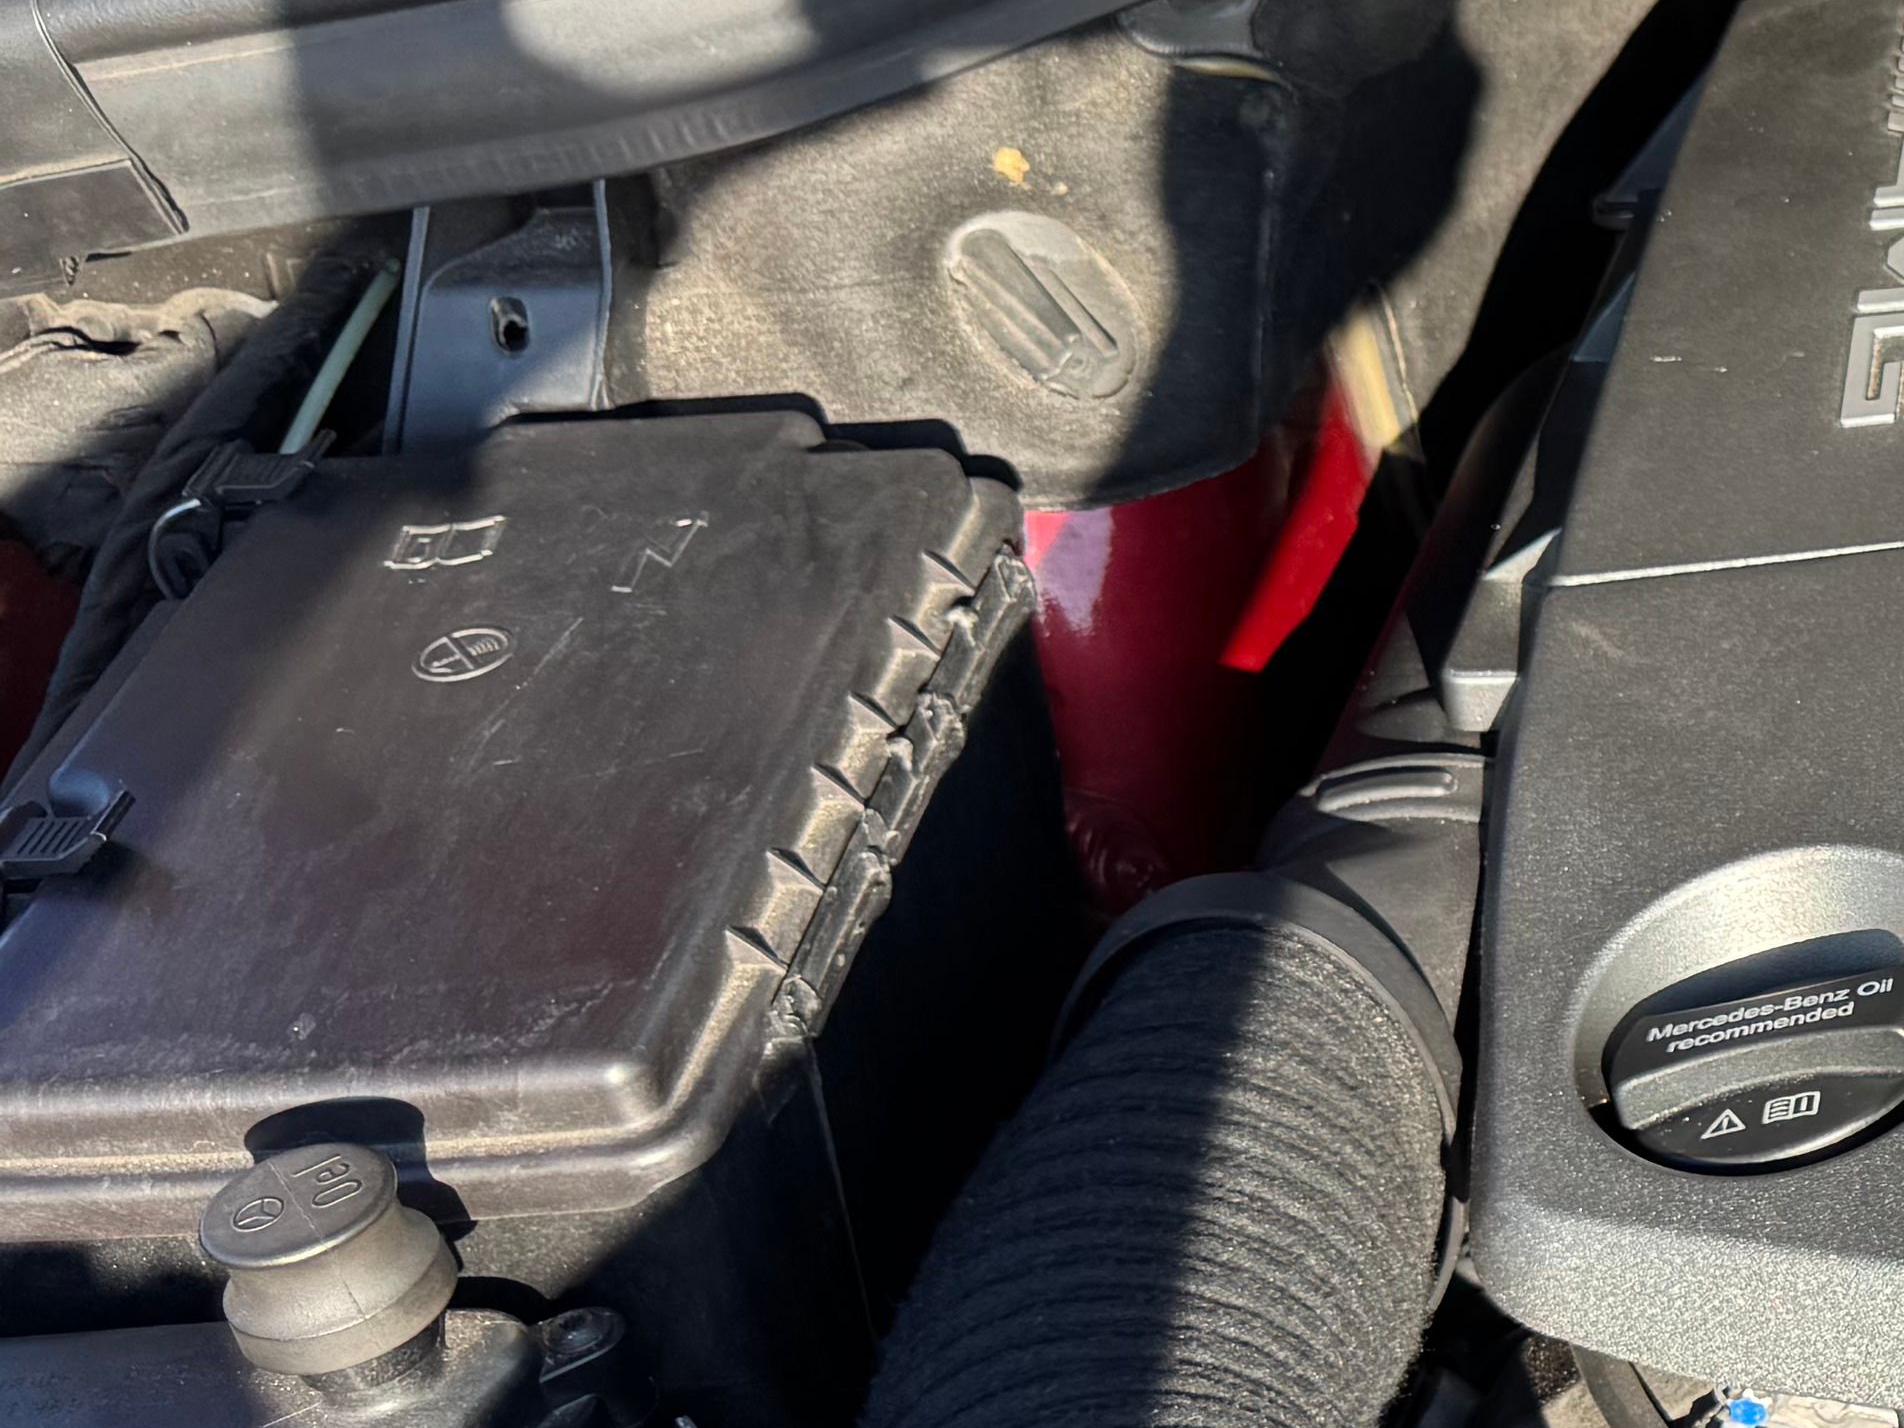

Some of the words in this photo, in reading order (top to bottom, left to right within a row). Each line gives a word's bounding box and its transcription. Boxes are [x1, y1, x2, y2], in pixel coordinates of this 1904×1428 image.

[1646, 988, 1851, 1043] Mercedes-Benz
[1857, 977, 1895, 998] Oil
[1664, 1001, 1856, 1054] recommended
[290, 1152, 364, 1210] Oel
